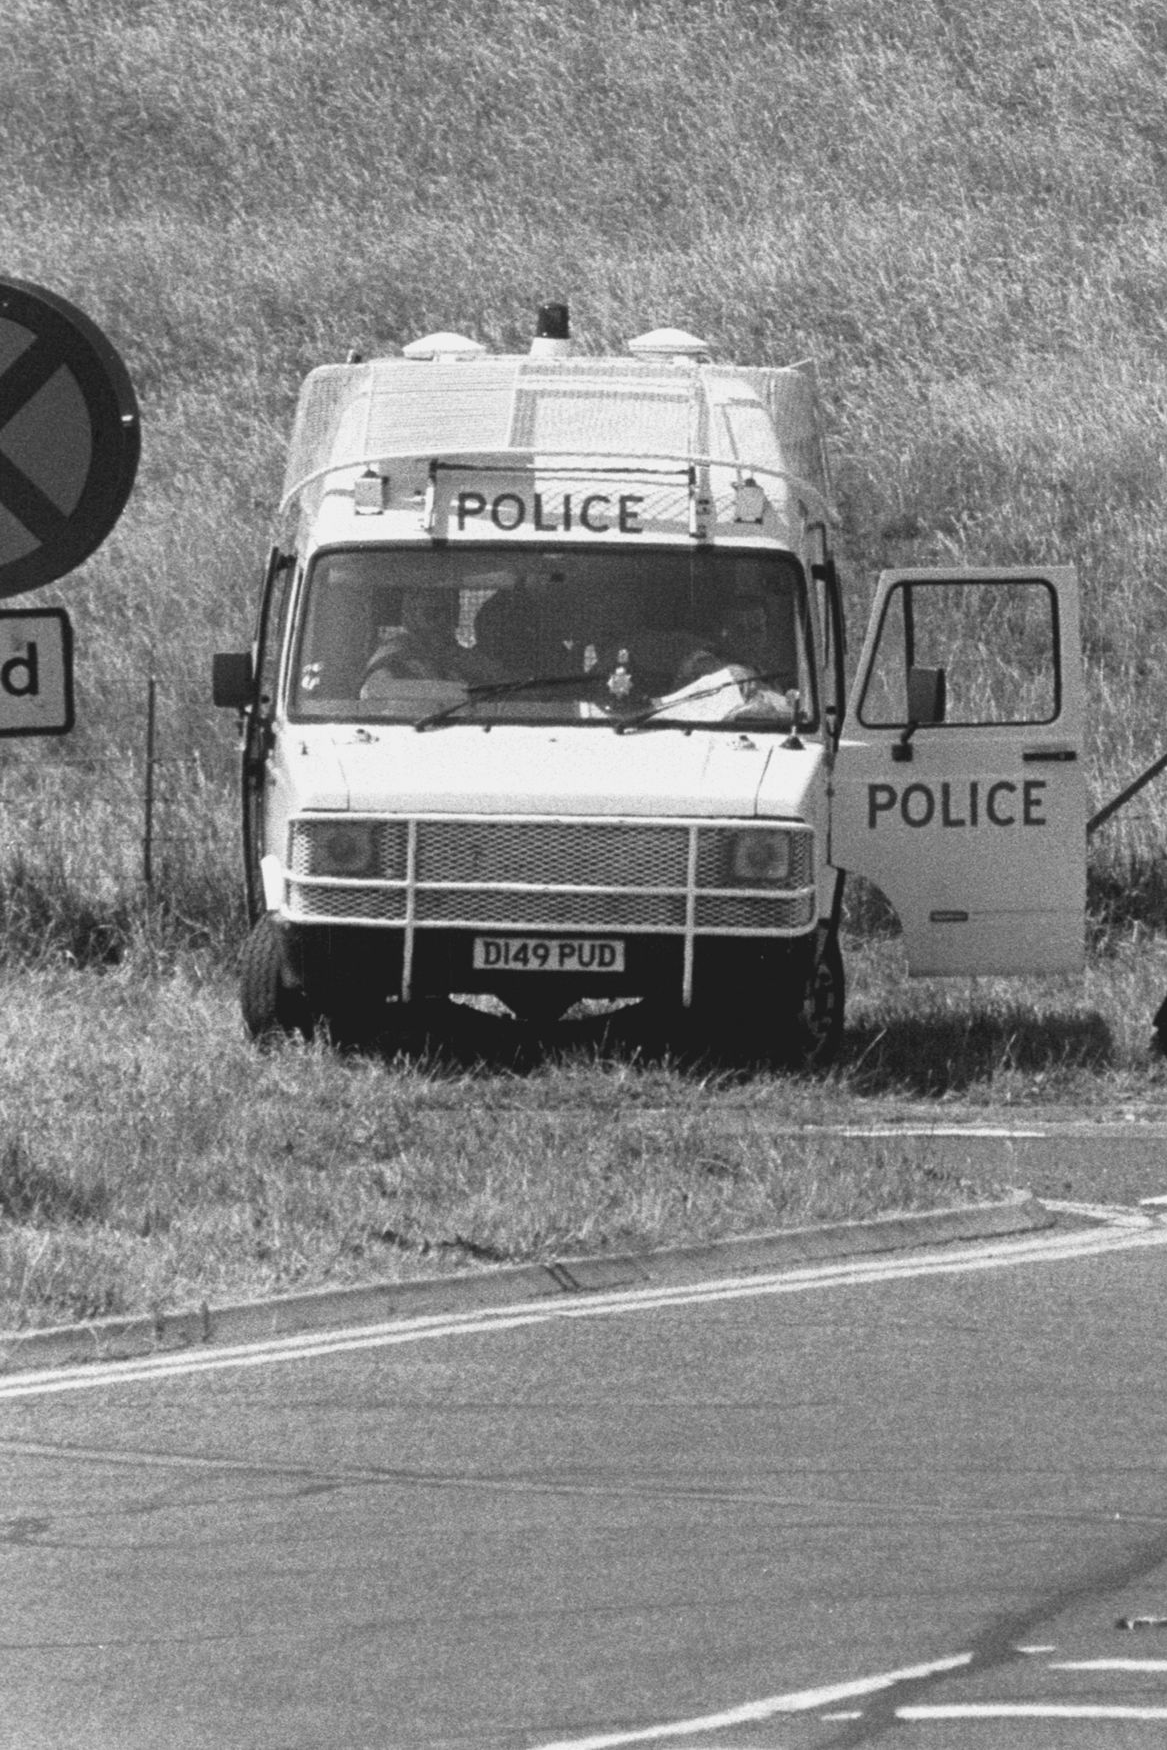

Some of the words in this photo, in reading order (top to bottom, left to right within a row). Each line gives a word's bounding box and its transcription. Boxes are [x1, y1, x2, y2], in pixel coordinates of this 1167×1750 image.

[458, 492, 644, 533] POLICE
[868, 780, 1046, 829] POLICE
[483, 941, 549, 967] D149
[558, 943, 616, 968] PUD
